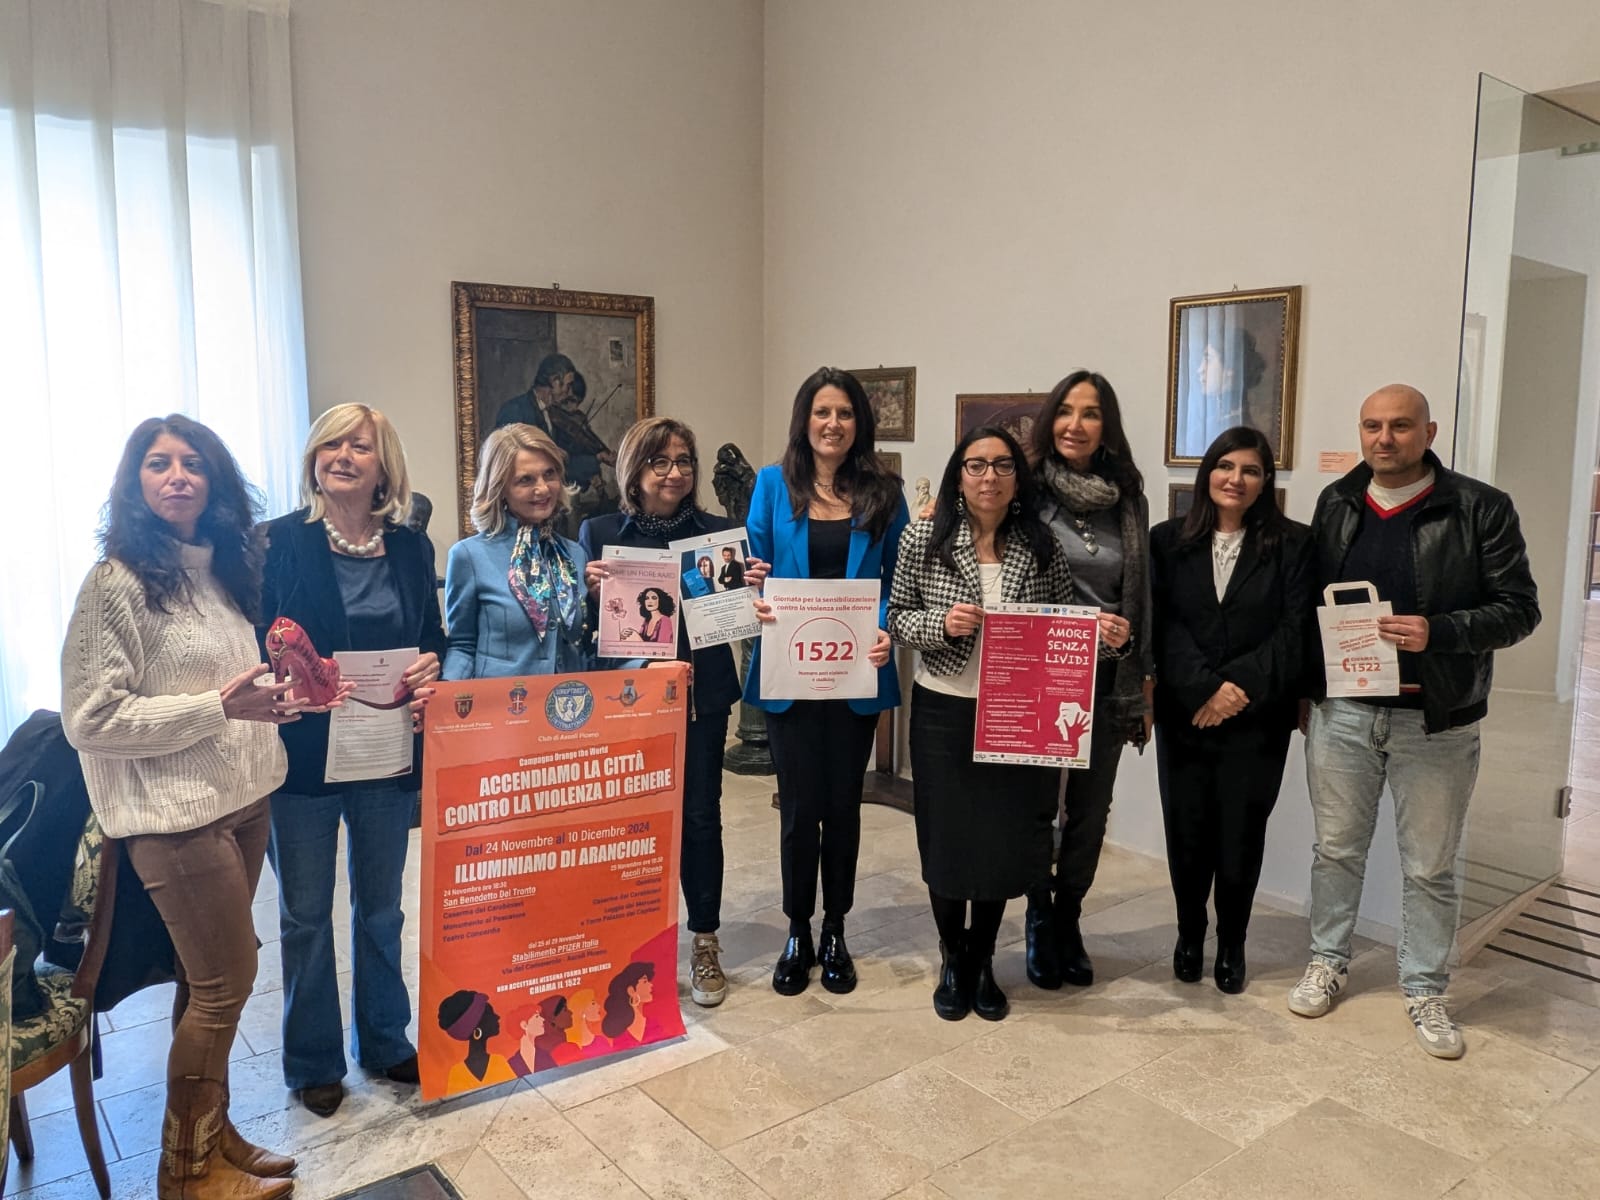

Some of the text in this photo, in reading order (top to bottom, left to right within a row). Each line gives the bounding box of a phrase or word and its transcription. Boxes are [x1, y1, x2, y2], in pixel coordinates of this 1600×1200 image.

[822, 595, 876, 603] sensibilizzazione
[1047, 627, 1091, 640] AMORE
[795, 641, 854, 661] 1522
[1047, 640, 1089, 653] SENZA
[1045, 653, 1089, 665] LIVIDI
[1351, 662, 1381, 672] 1522
[519, 746, 608, 766] Campagna Orange the World
[480, 750, 645, 797] ACCENDIAMO LA CITTÀ
[445, 768, 671, 827] CONTRO LA VIOLENZA DI GENERE
[465, 822, 650, 856] Dal 24 Novembre al 10 Dicembre 2024
[455, 837, 656, 884] ILLUMINIAMO DI ARANCIONE
[621, 865, 663, 879] Ascoli Piceno
[443, 886, 536, 908] San Benedetto Del Tronto
[452, 886, 481, 895] Novembre
[443, 901, 524, 919] Caserma dei Carabinieri
[443, 919, 483, 931] Monumento
[443, 932, 465, 943] Teatro
[559, 933, 585, 943] Novembre
[512, 939, 599, 963] Stabilimento PFIZER Italia
[509, 979, 539, 991] ACCETTARE
[540, 972, 563, 984] NESSUNA
[564, 969, 581, 978] FORMA
[589, 962, 612, 973] VIOLENZA
[529, 977, 581, 995] CHIAMA IL 1522
